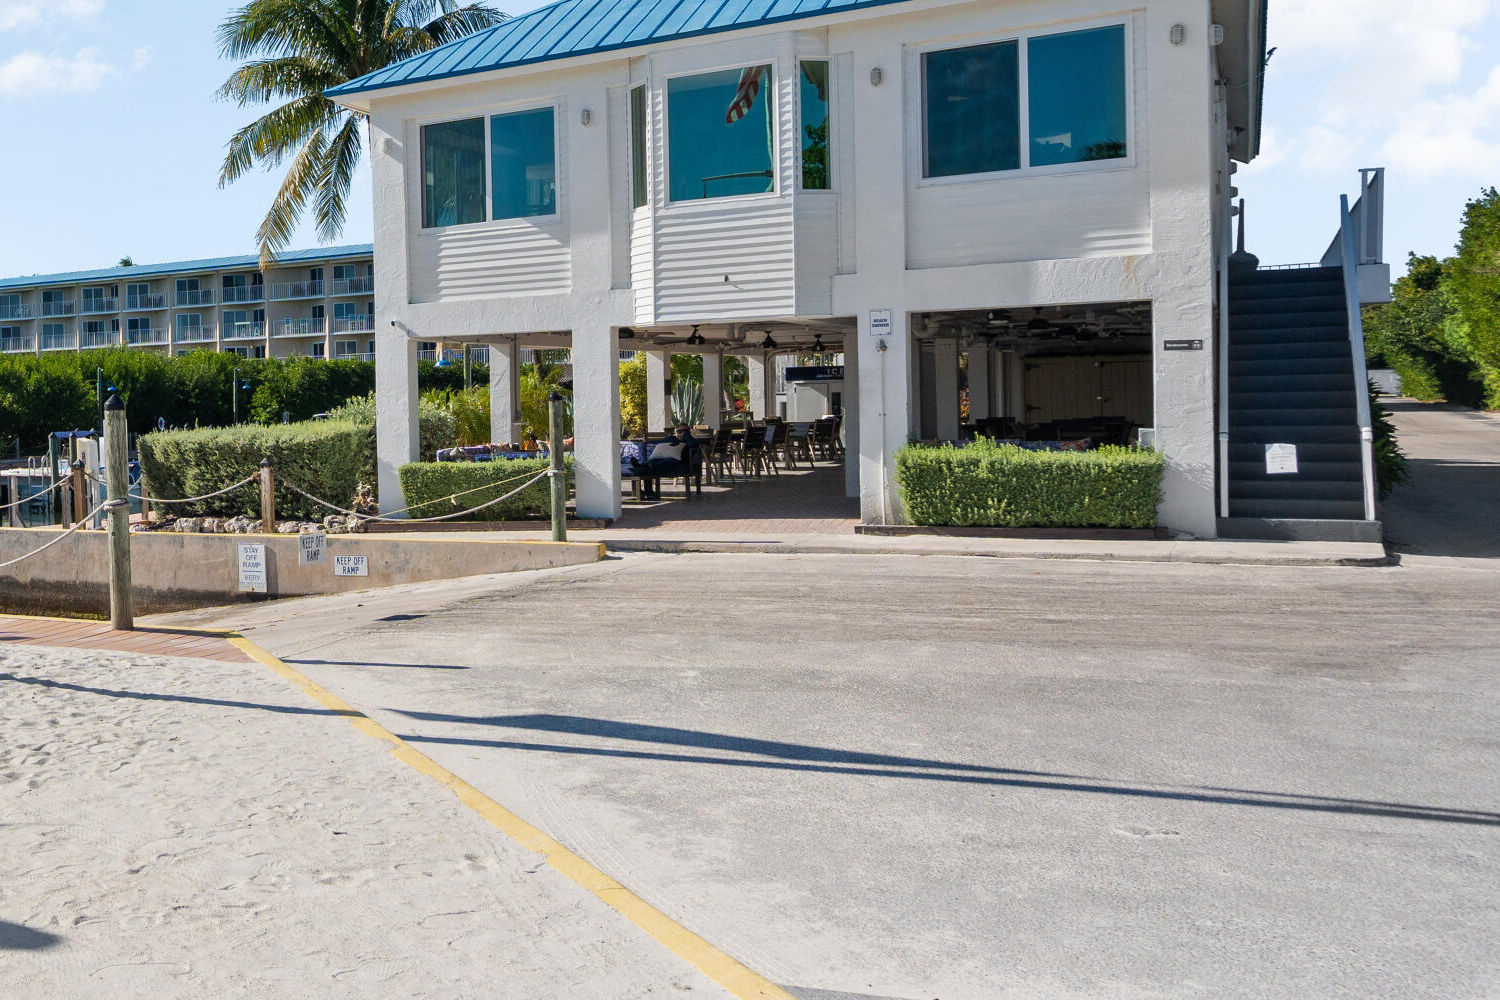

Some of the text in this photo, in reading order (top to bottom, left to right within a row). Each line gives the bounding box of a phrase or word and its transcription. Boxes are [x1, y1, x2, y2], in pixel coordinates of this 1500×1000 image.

[302, 535, 324, 549] KEEP OFF
[307, 549, 319, 561] RAMP
[336, 557, 364, 565] KEEP OFF
[342, 566, 359, 574] RAMP
